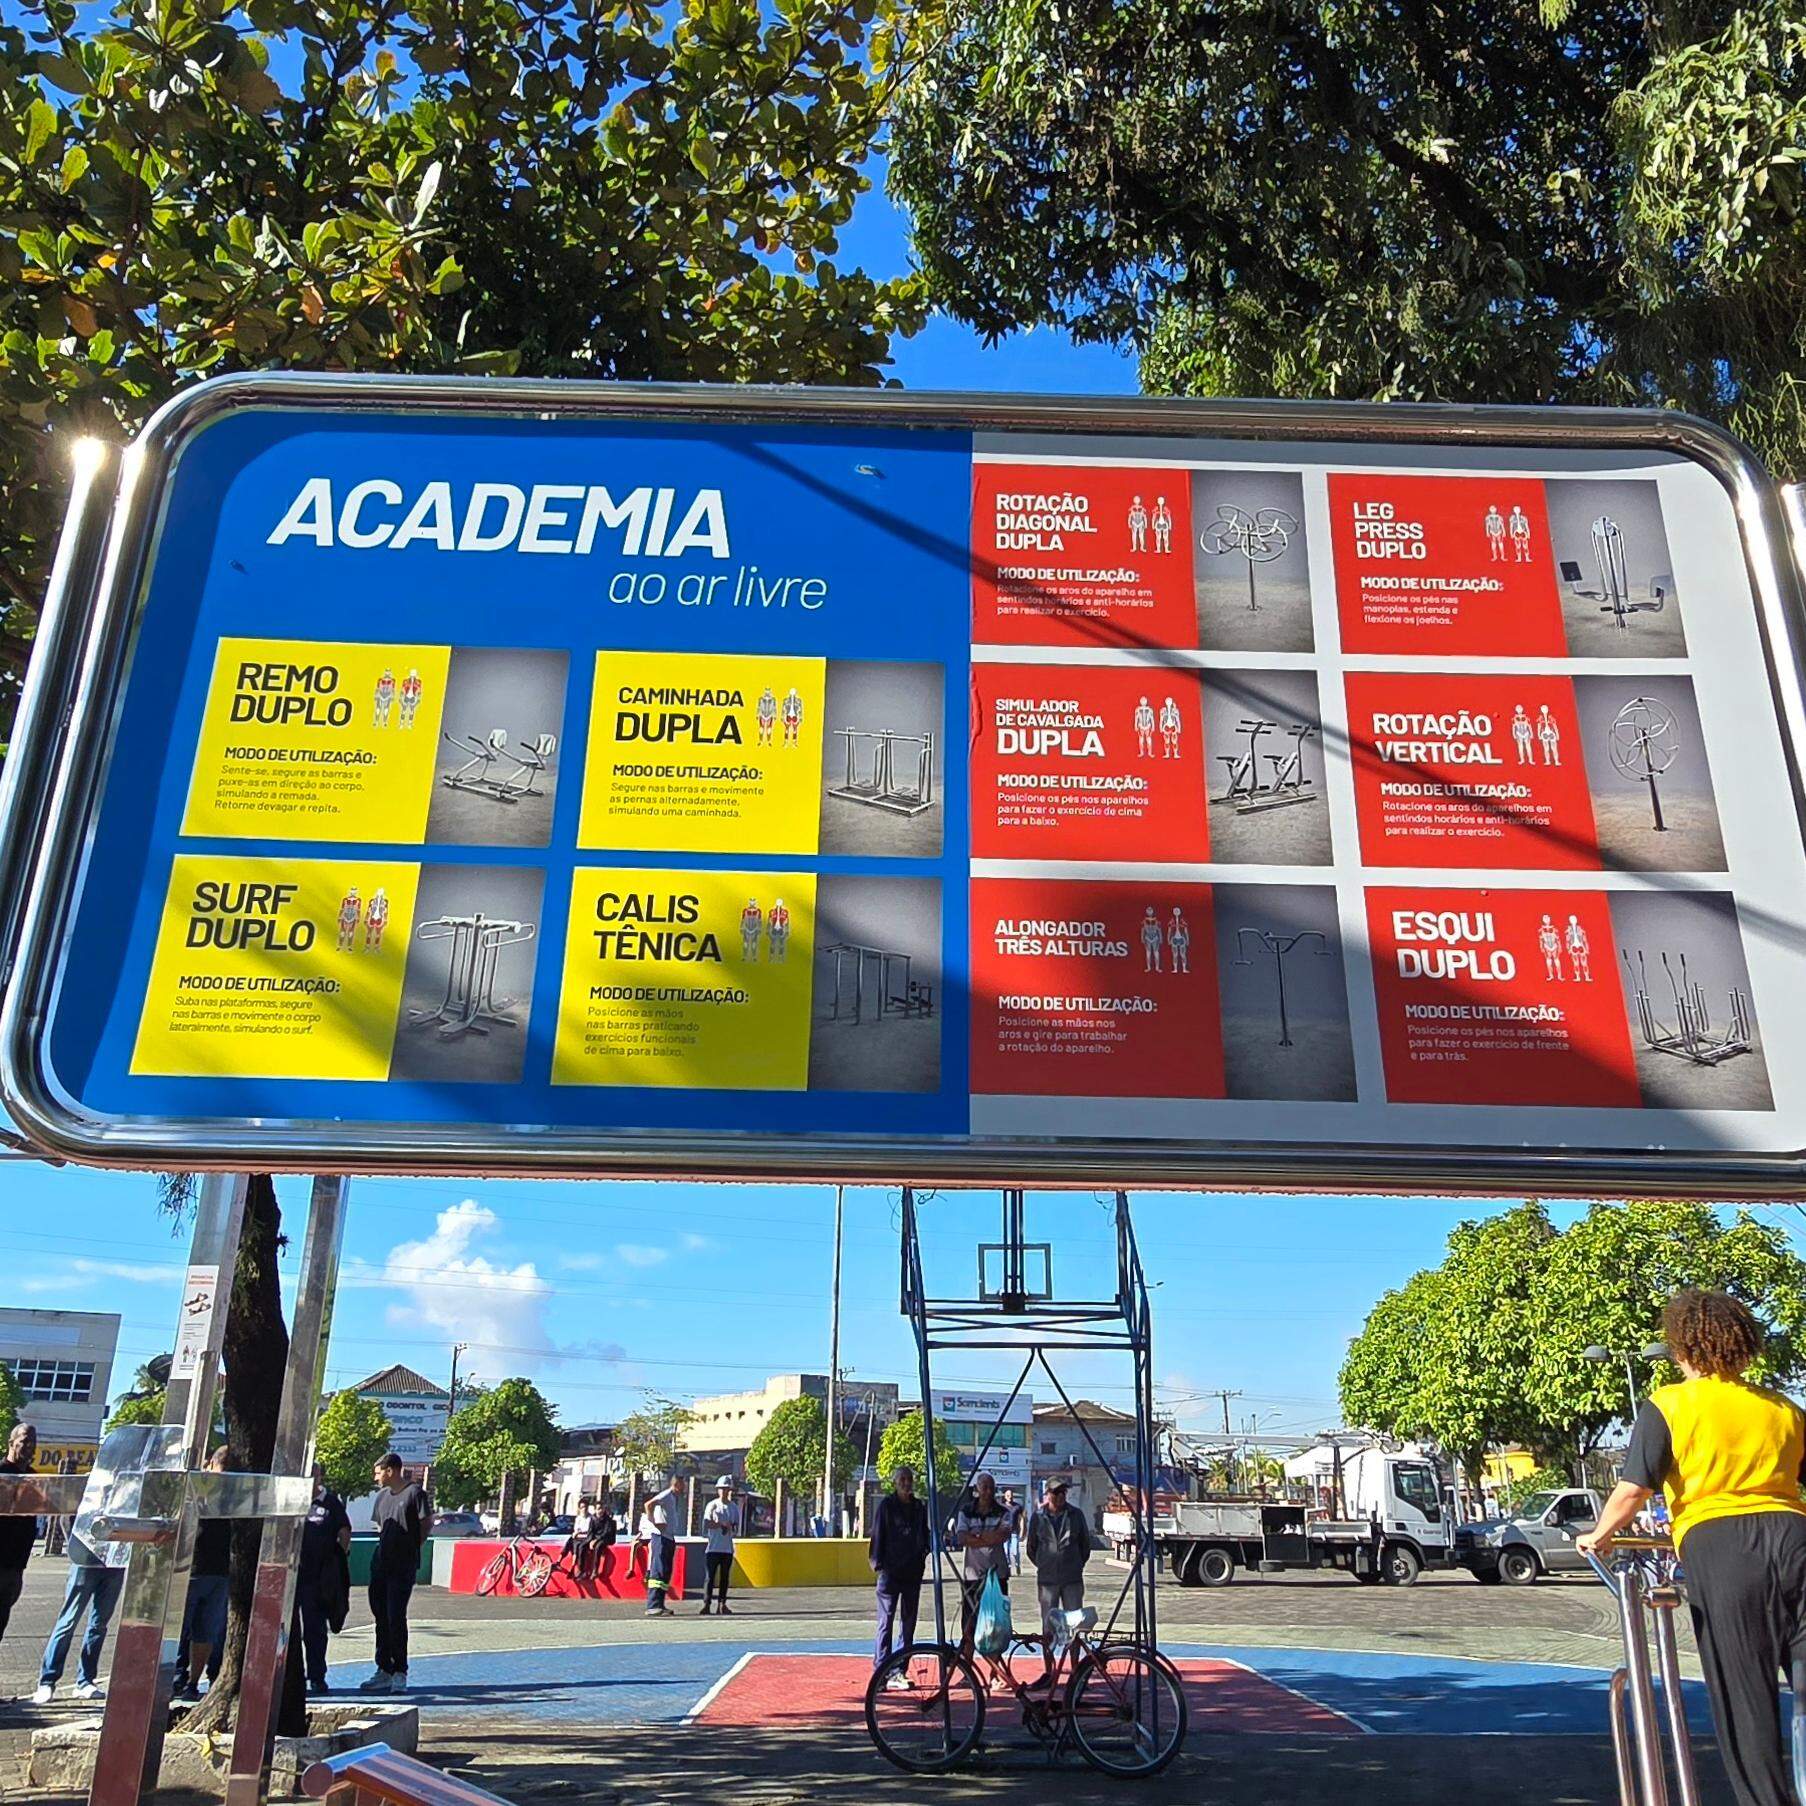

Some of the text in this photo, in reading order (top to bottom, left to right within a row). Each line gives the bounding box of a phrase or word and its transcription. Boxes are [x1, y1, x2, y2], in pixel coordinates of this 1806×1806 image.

[996, 492, 1088, 515] ROTAÇÃO
[1353, 502, 1393, 519] LEG
[266, 478, 730, 559] ACADEMIA
[996, 514, 1097, 533] DIAGONAL
[1355, 522, 1424, 539] PRESS
[996, 533, 1064, 551] DUPLA
[1356, 541, 1426, 559] DUPLO
[998, 568, 1035, 580] MODO
[1038, 568, 1055, 580] DE
[608, 566, 827, 610] ao ar livre
[1361, 577, 1399, 589] MODO
[1401, 578, 1419, 589] DE
[236, 662, 339, 693] REMO
[619, 687, 744, 707] CAMINHADA
[230, 694, 352, 727] DUPLO
[996, 699, 1079, 713] SIMULADOR
[615, 712, 742, 744] DUPLA
[996, 714, 1104, 728] DE CAVALGADA
[1372, 710, 1492, 739] ROTAÇÃO
[997, 729, 1105, 757] DUPLA
[224, 747, 377, 766] MODO DE UTILIZAÇÃO:
[1375, 741, 1502, 764] VERTICAL
[272, 769, 306, 778] segure
[322, 770, 353, 778] barras
[613, 765, 763, 782] MODO DE UTILIZAÇÃO:
[611, 783, 764, 795] Segure nas barras movimente
[998, 774, 1148, 792] MODO DE UTILIZAÇÃO:
[1381, 783, 1421, 796] MODO
[1424, 784, 1443, 796] DE
[216, 790, 268, 798] simulando
[624, 796, 657, 804] pernas
[998, 793, 1045, 802] Posicione
[215, 800, 255, 809] Retorne
[258, 802, 296, 812] devagar
[609, 806, 659, 816] simulando
[662, 808, 682, 816] uma
[998, 806, 1020, 815] para
[1021, 806, 1046, 814] fazer
[1383, 801, 1432, 811] Rotacione
[998, 818, 1019, 826] para
[1385, 827, 1445, 836] para realizar
[192, 882, 298, 915] SURF
[596, 892, 699, 923] CALIS
[186, 917, 315, 951] DUPLO
[994, 920, 1105, 937] ALONGADOR
[1392, 911, 1495, 945] ESQUI
[594, 924, 722, 962] TÊNICA
[995, 937, 1128, 957] TRÊS ALTURAS
[1397, 949, 1516, 980] DUPLO
[179, 976, 340, 995] MODO DE UTILIZAÇÃO:
[175, 996, 313, 1011] Suba nas segure
[590, 987, 749, 1005] MODO DE UTILIZAÇÃO:
[588, 1007, 639, 1017] Posicione
[999, 996, 1158, 1014] MODO DE UTILIZAÇÃO:
[1405, 1004, 1565, 1023] MODO DE UTILIZAÇÃO:
[191, 1010, 221, 1019] barras
[230, 1011, 283, 1020] movimente
[293, 1014, 321, 1023] corpo
[587, 1021, 605, 1029] nas
[607, 1020, 640, 1030] barras
[234, 1024, 282, 1033] simulando
[584, 1045, 650, 1056] de cima para
